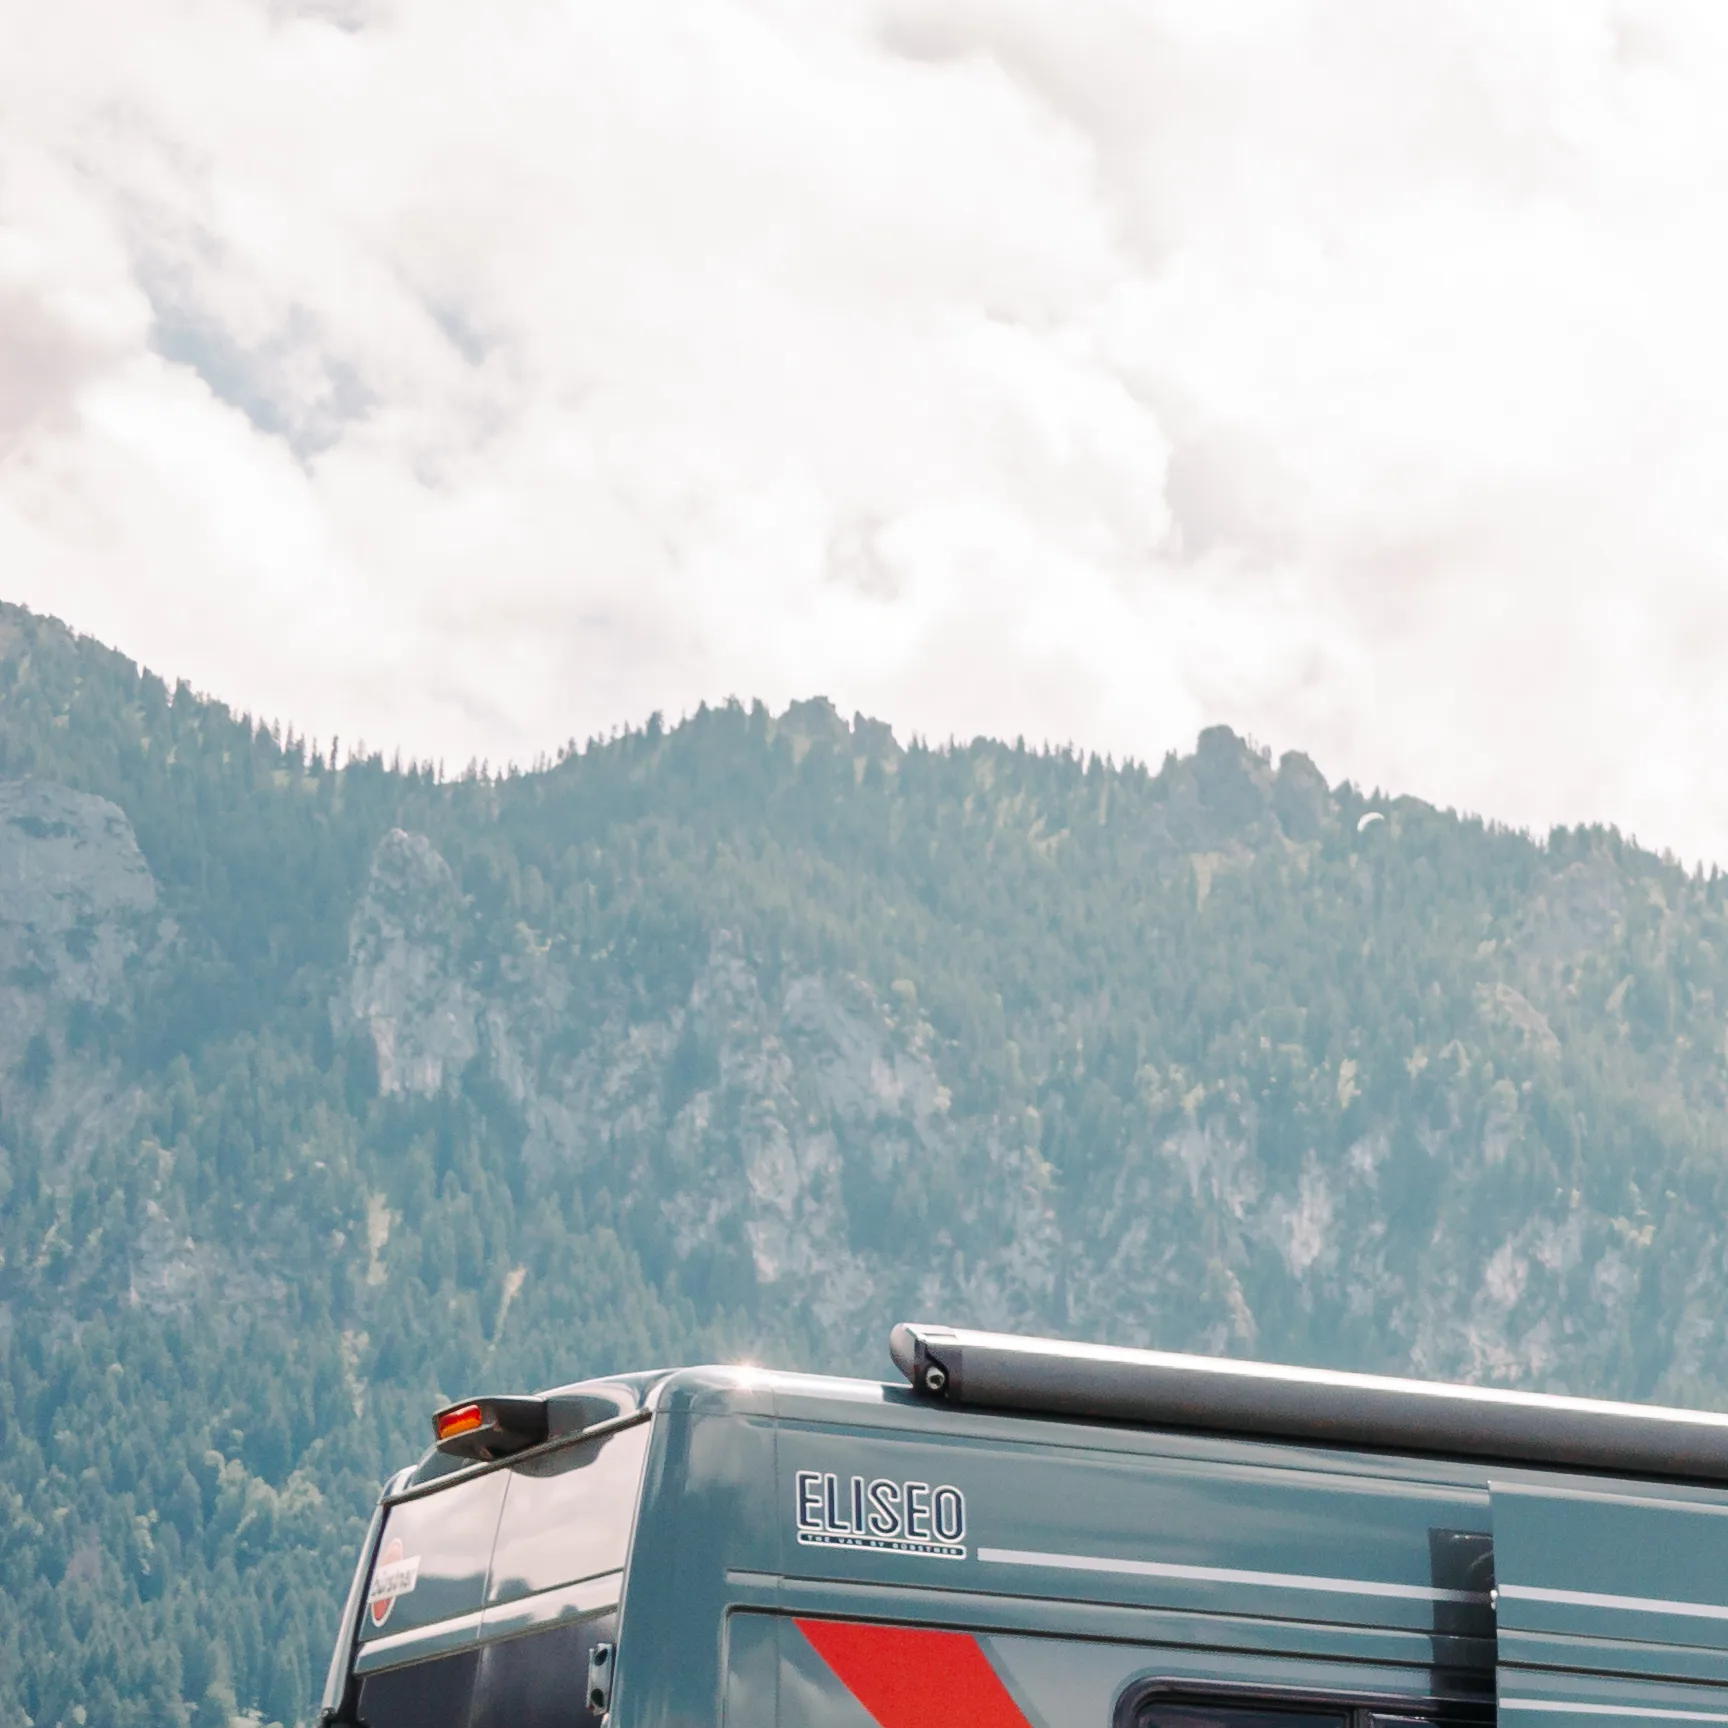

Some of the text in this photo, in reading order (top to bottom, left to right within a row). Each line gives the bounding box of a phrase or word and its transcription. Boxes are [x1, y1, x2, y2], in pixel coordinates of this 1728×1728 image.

[796, 1471, 965, 1543] ELISEO
[807, 1534, 830, 1543] THE
[838, 1537, 863, 1546] VAN
